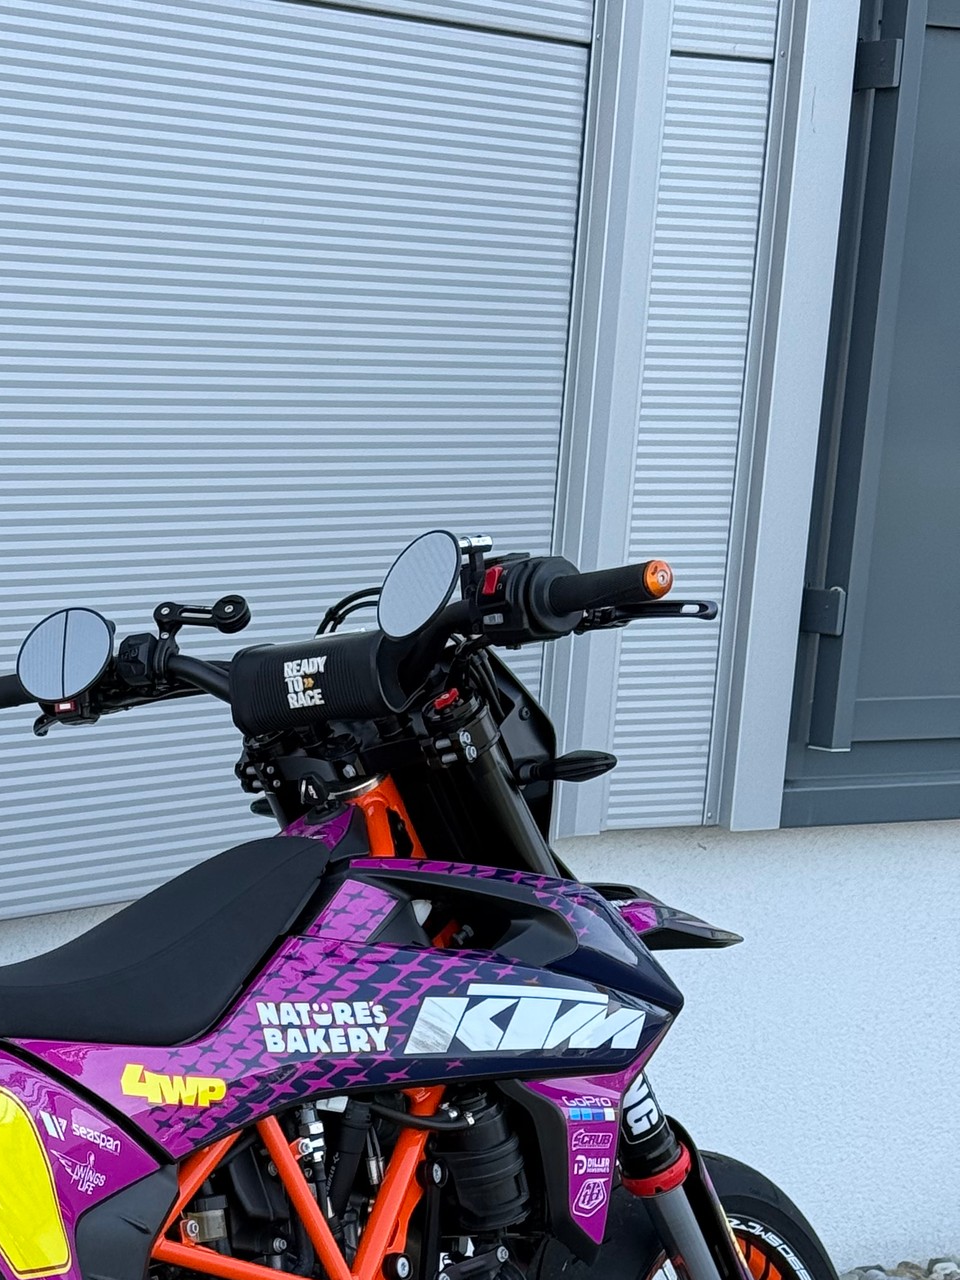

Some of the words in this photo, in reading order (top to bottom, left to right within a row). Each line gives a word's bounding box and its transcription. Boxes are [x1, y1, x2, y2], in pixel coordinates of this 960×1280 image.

[284, 656, 327, 678] READY
[284, 676, 304, 693] TO
[287, 688, 325, 709] RACE
[403, 983, 646, 1055] KTM
[262, 1025, 390, 1054] BAKERY
[120, 1063, 227, 1108] 4WP
[71, 1122, 121, 1154] seaspan
[72, 1164, 106, 1187] WINGS
